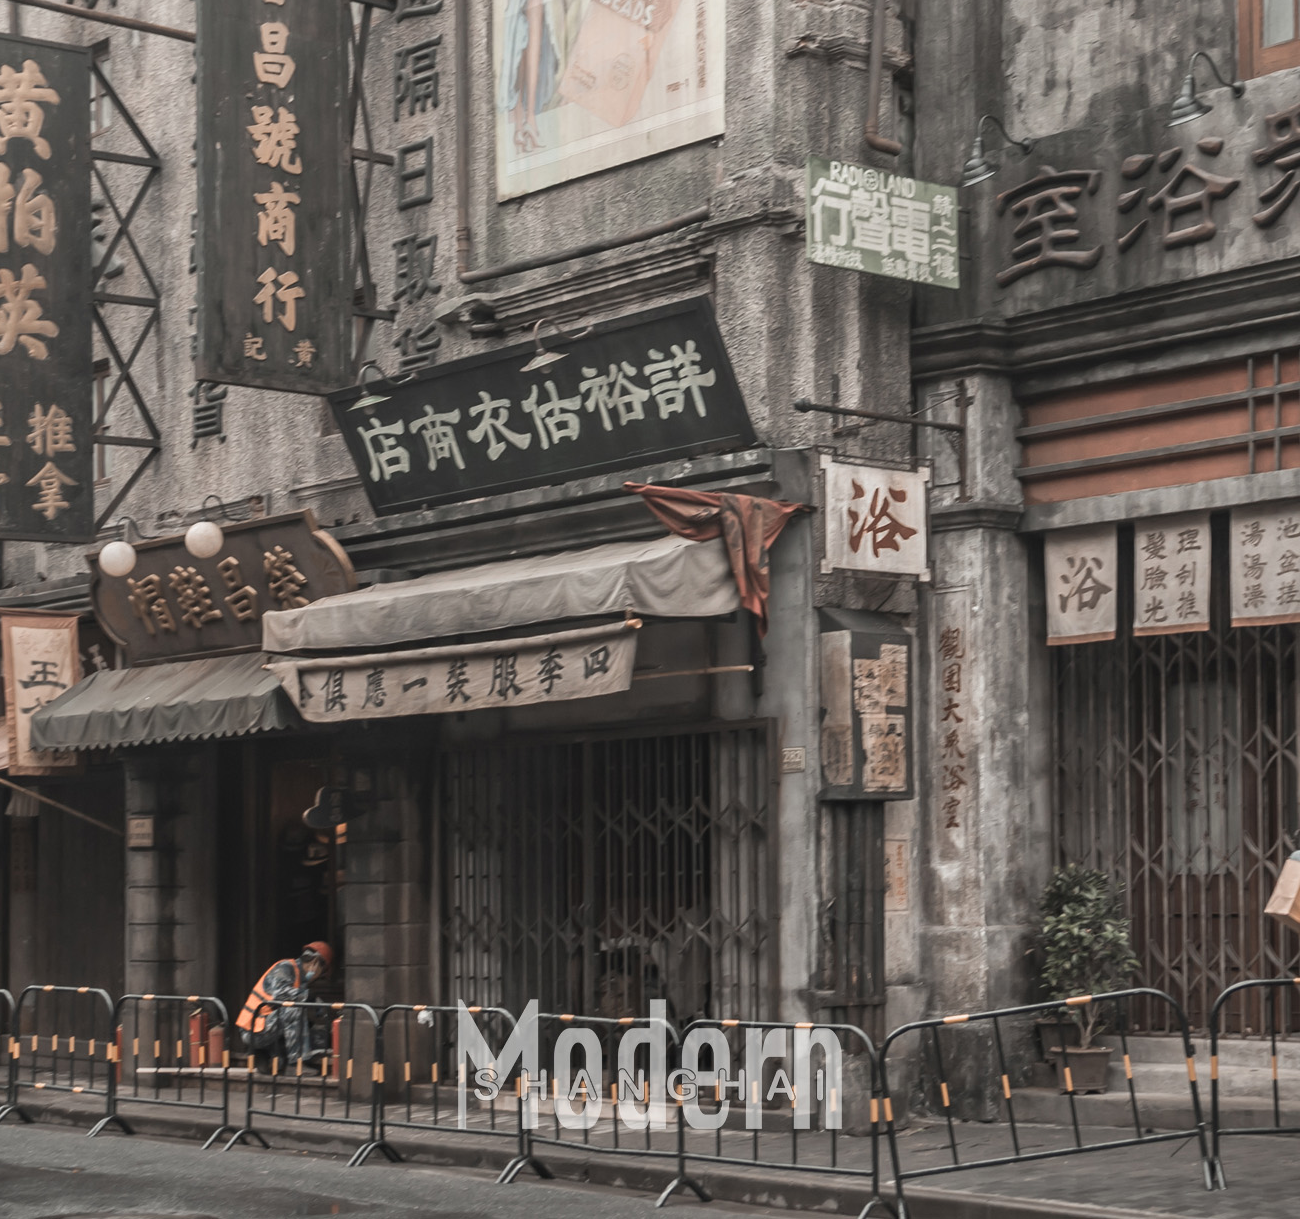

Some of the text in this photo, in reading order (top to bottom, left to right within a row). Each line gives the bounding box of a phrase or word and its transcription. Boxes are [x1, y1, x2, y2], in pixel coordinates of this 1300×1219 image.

[26, 402, 78, 521] 推拿
[847, 478, 919, 558] 浴
[1059, 556, 1113, 615] 浴
